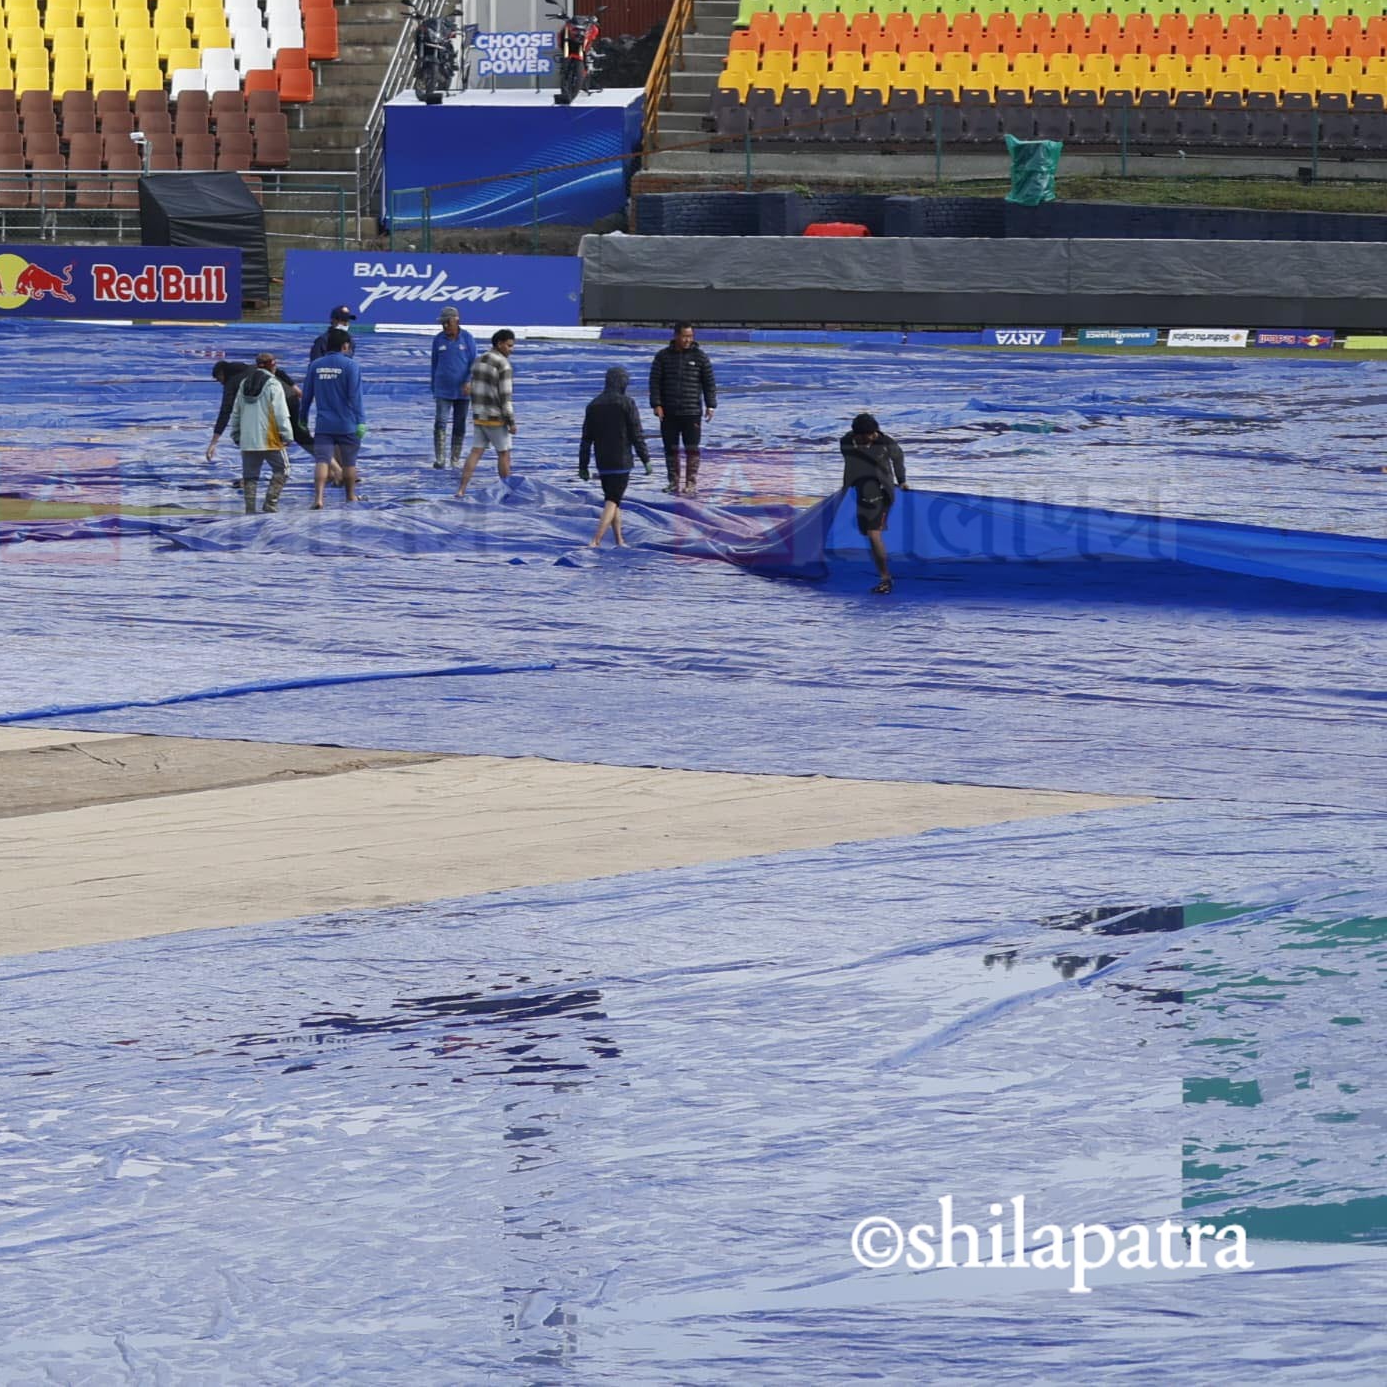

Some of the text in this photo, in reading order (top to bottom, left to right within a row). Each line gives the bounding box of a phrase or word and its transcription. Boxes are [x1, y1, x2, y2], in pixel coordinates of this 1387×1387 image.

[476, 33, 553, 48] CHOOSE
[487, 47, 538, 60] YOUR
[480, 59, 550, 74] POWER
[354, 262, 433, 279] BAJAJ
[91, 264, 227, 303] Red Bull
[360, 270, 511, 313] pulsar
[995, 333, 1046, 345] ARYA
